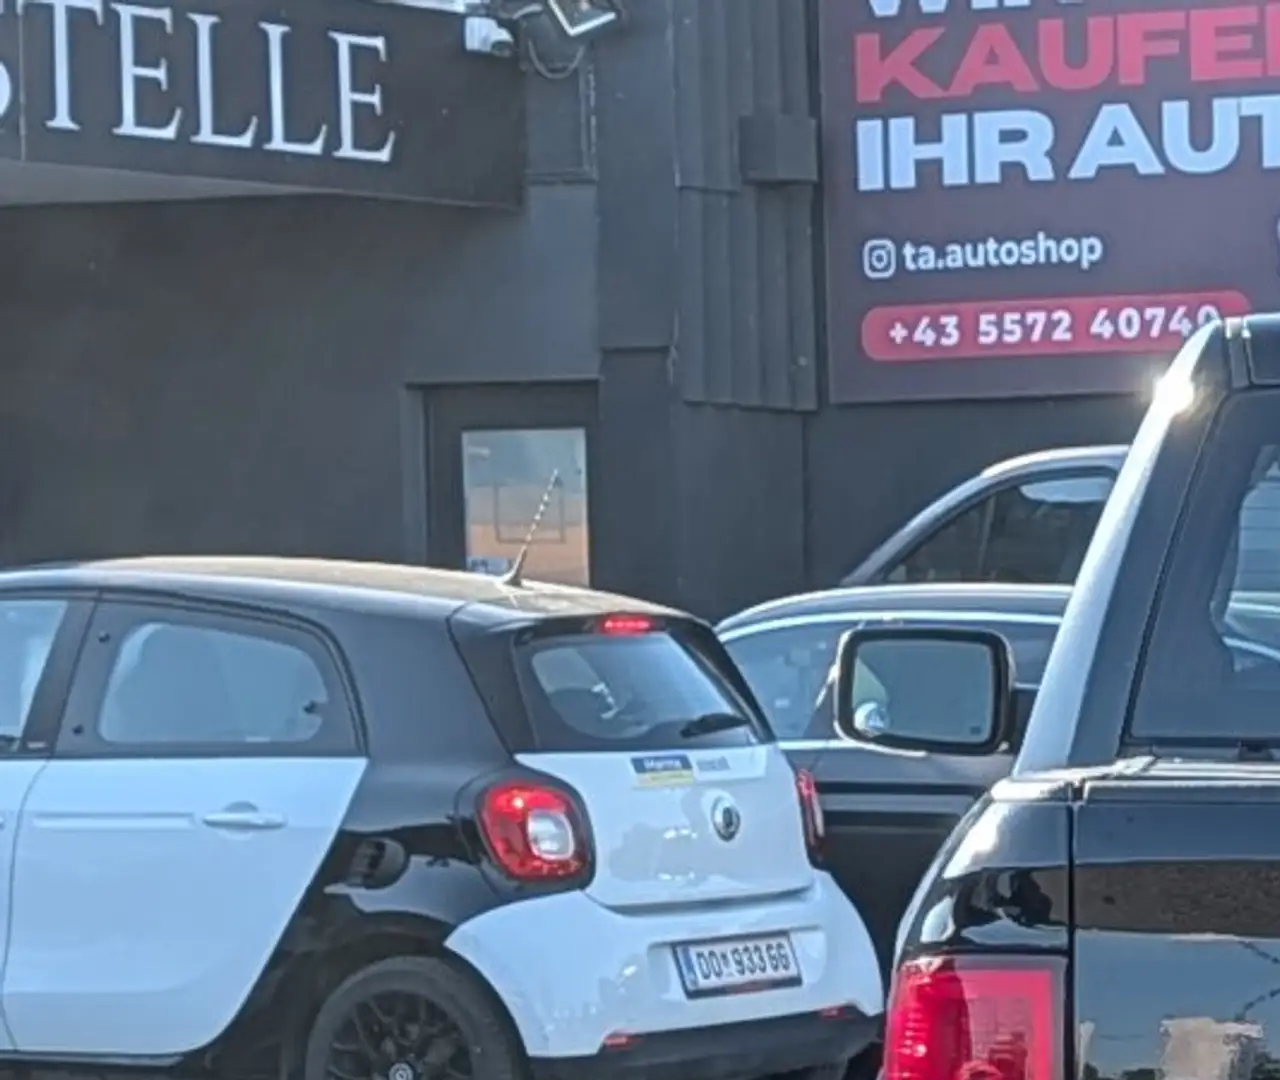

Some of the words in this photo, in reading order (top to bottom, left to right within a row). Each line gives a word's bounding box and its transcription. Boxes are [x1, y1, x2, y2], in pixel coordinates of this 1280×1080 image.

[0, 0, 396, 163] TELLE
[856, 110, 1055, 191] IHR
[902, 231, 1103, 271] ta.autoshop
[888, 314, 960, 347] +43
[977, 309, 1073, 345] 5572
